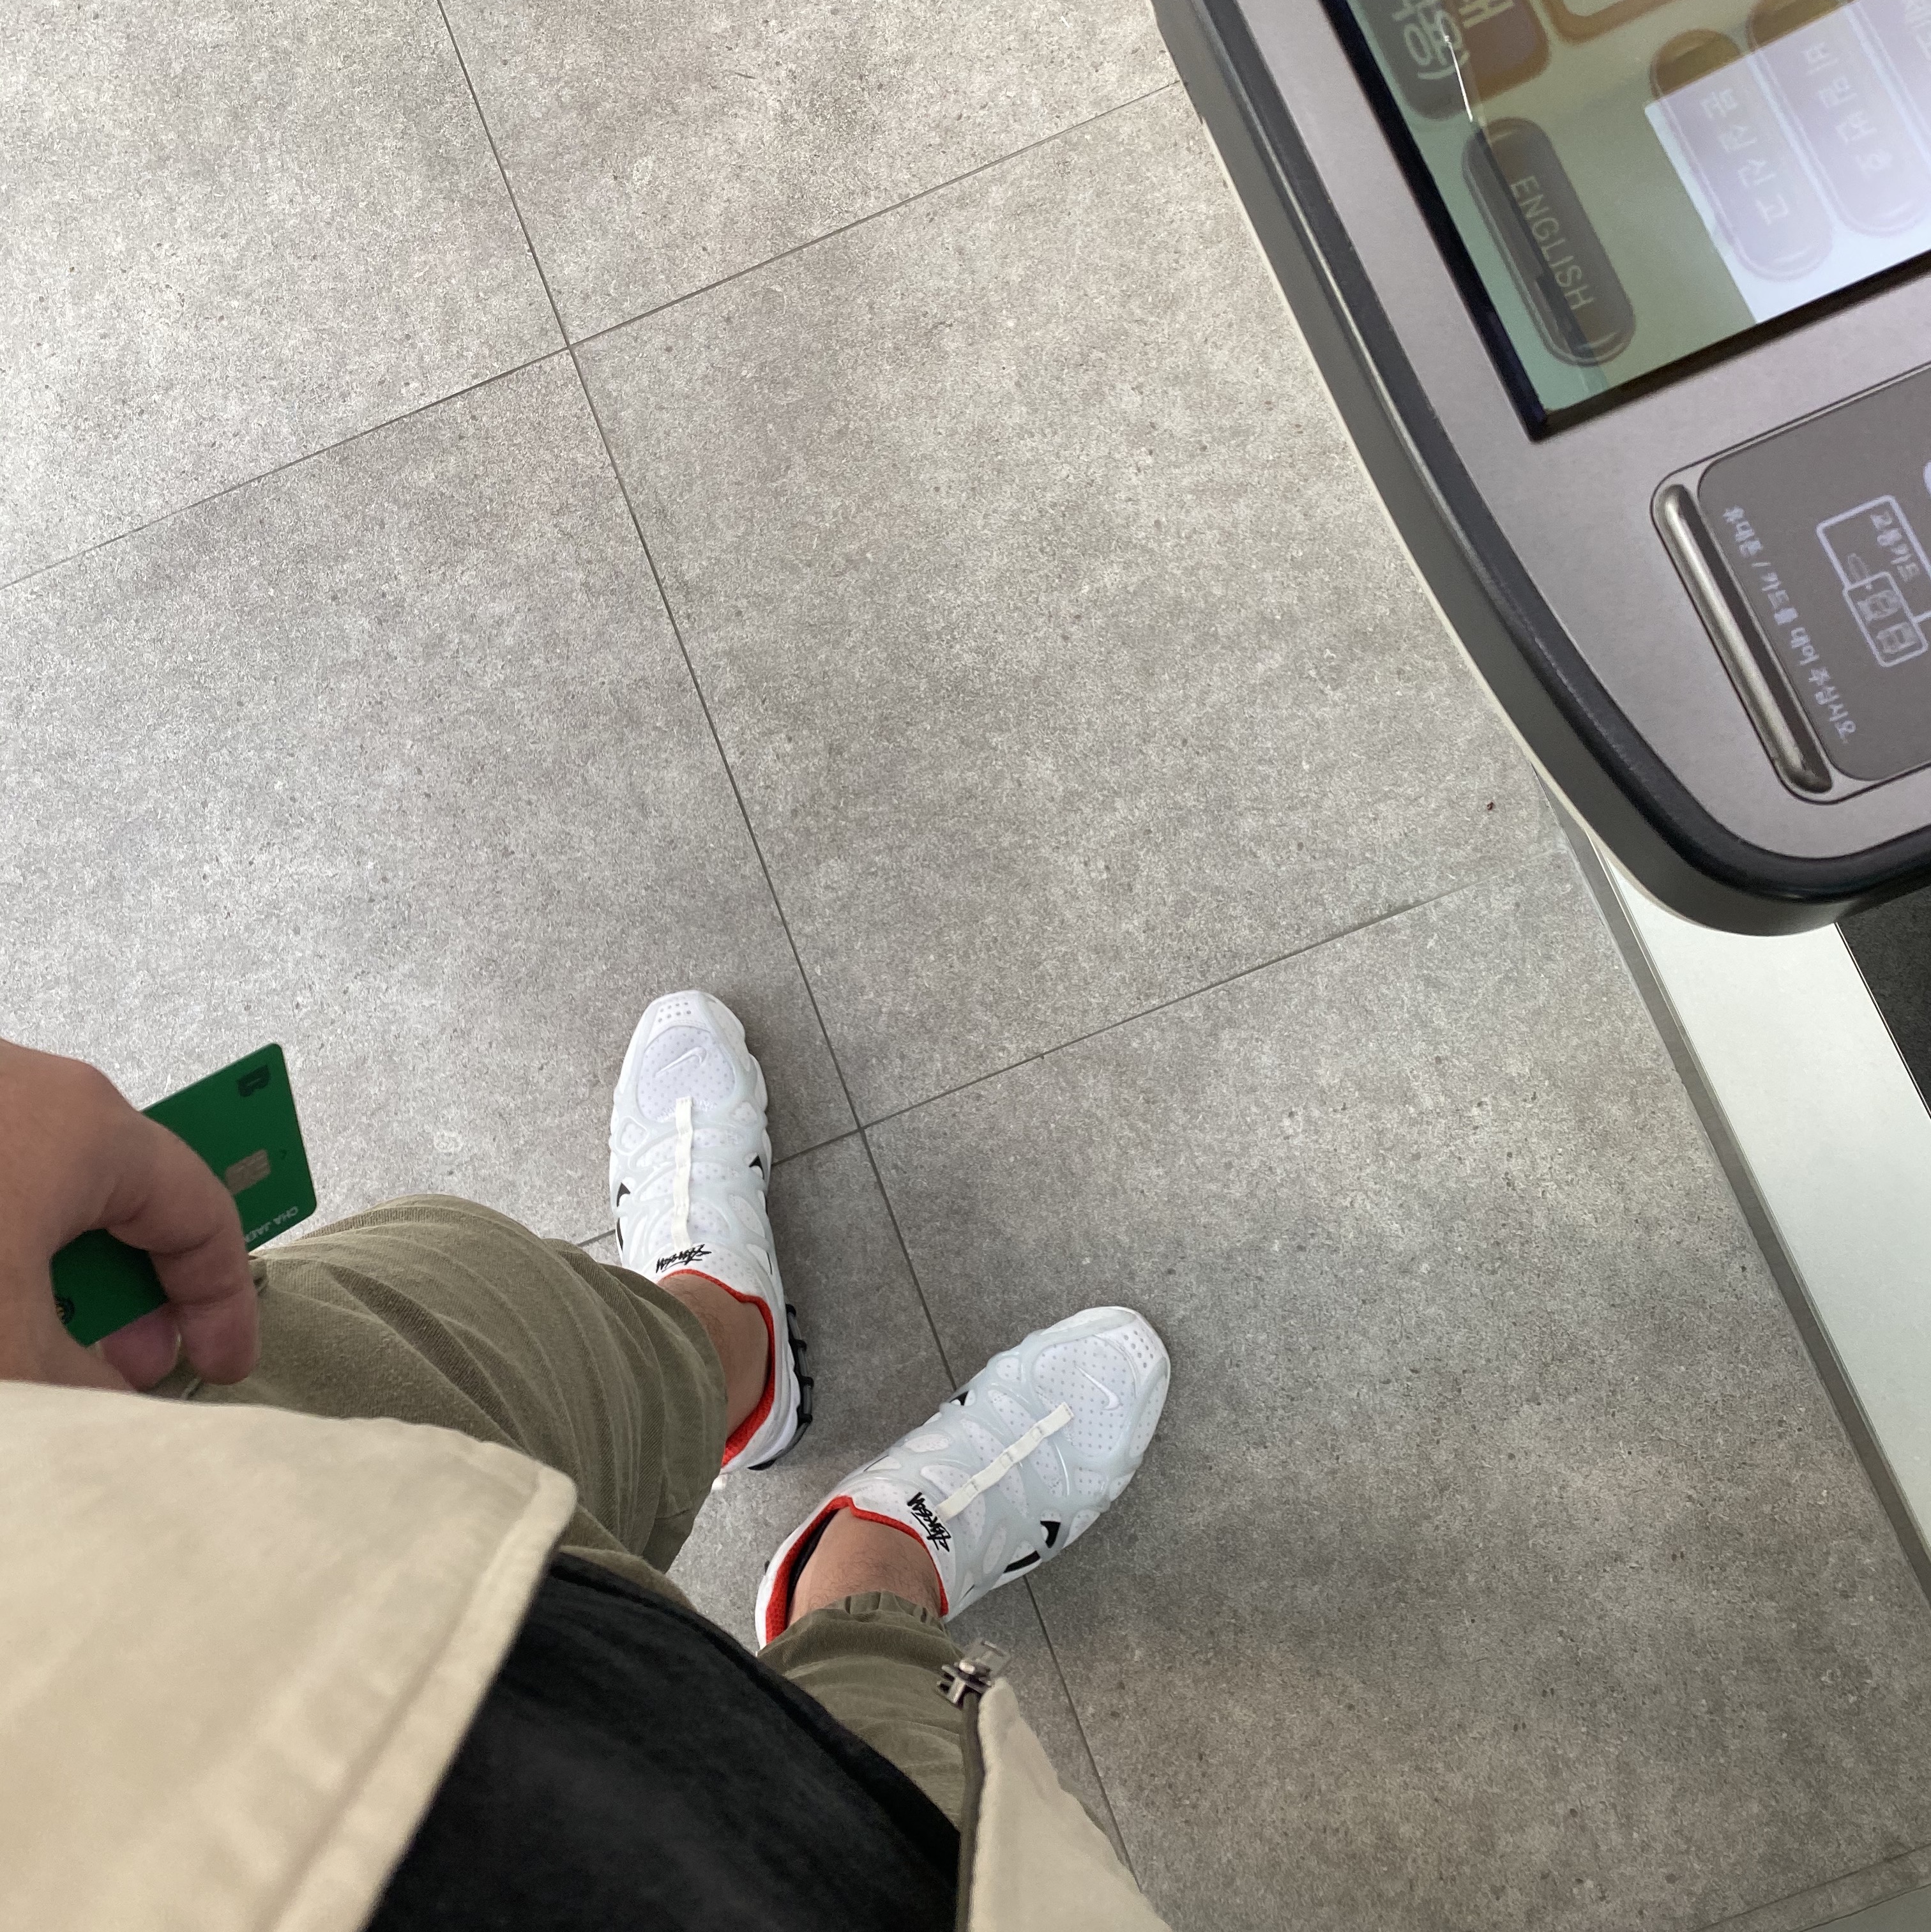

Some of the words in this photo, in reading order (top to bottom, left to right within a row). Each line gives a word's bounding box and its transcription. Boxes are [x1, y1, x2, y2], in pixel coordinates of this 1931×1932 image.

[1700, 89, 1789, 224] 분실신고
[1802, 42, 1892, 175] 비밀번호
[1510, 177, 1595, 312] ENGLISH
[1724, 506, 1763, 556] 휴대폰
[1762, 572, 1798, 625] 카드를
[1871, 512, 1919, 581] 교통카드
